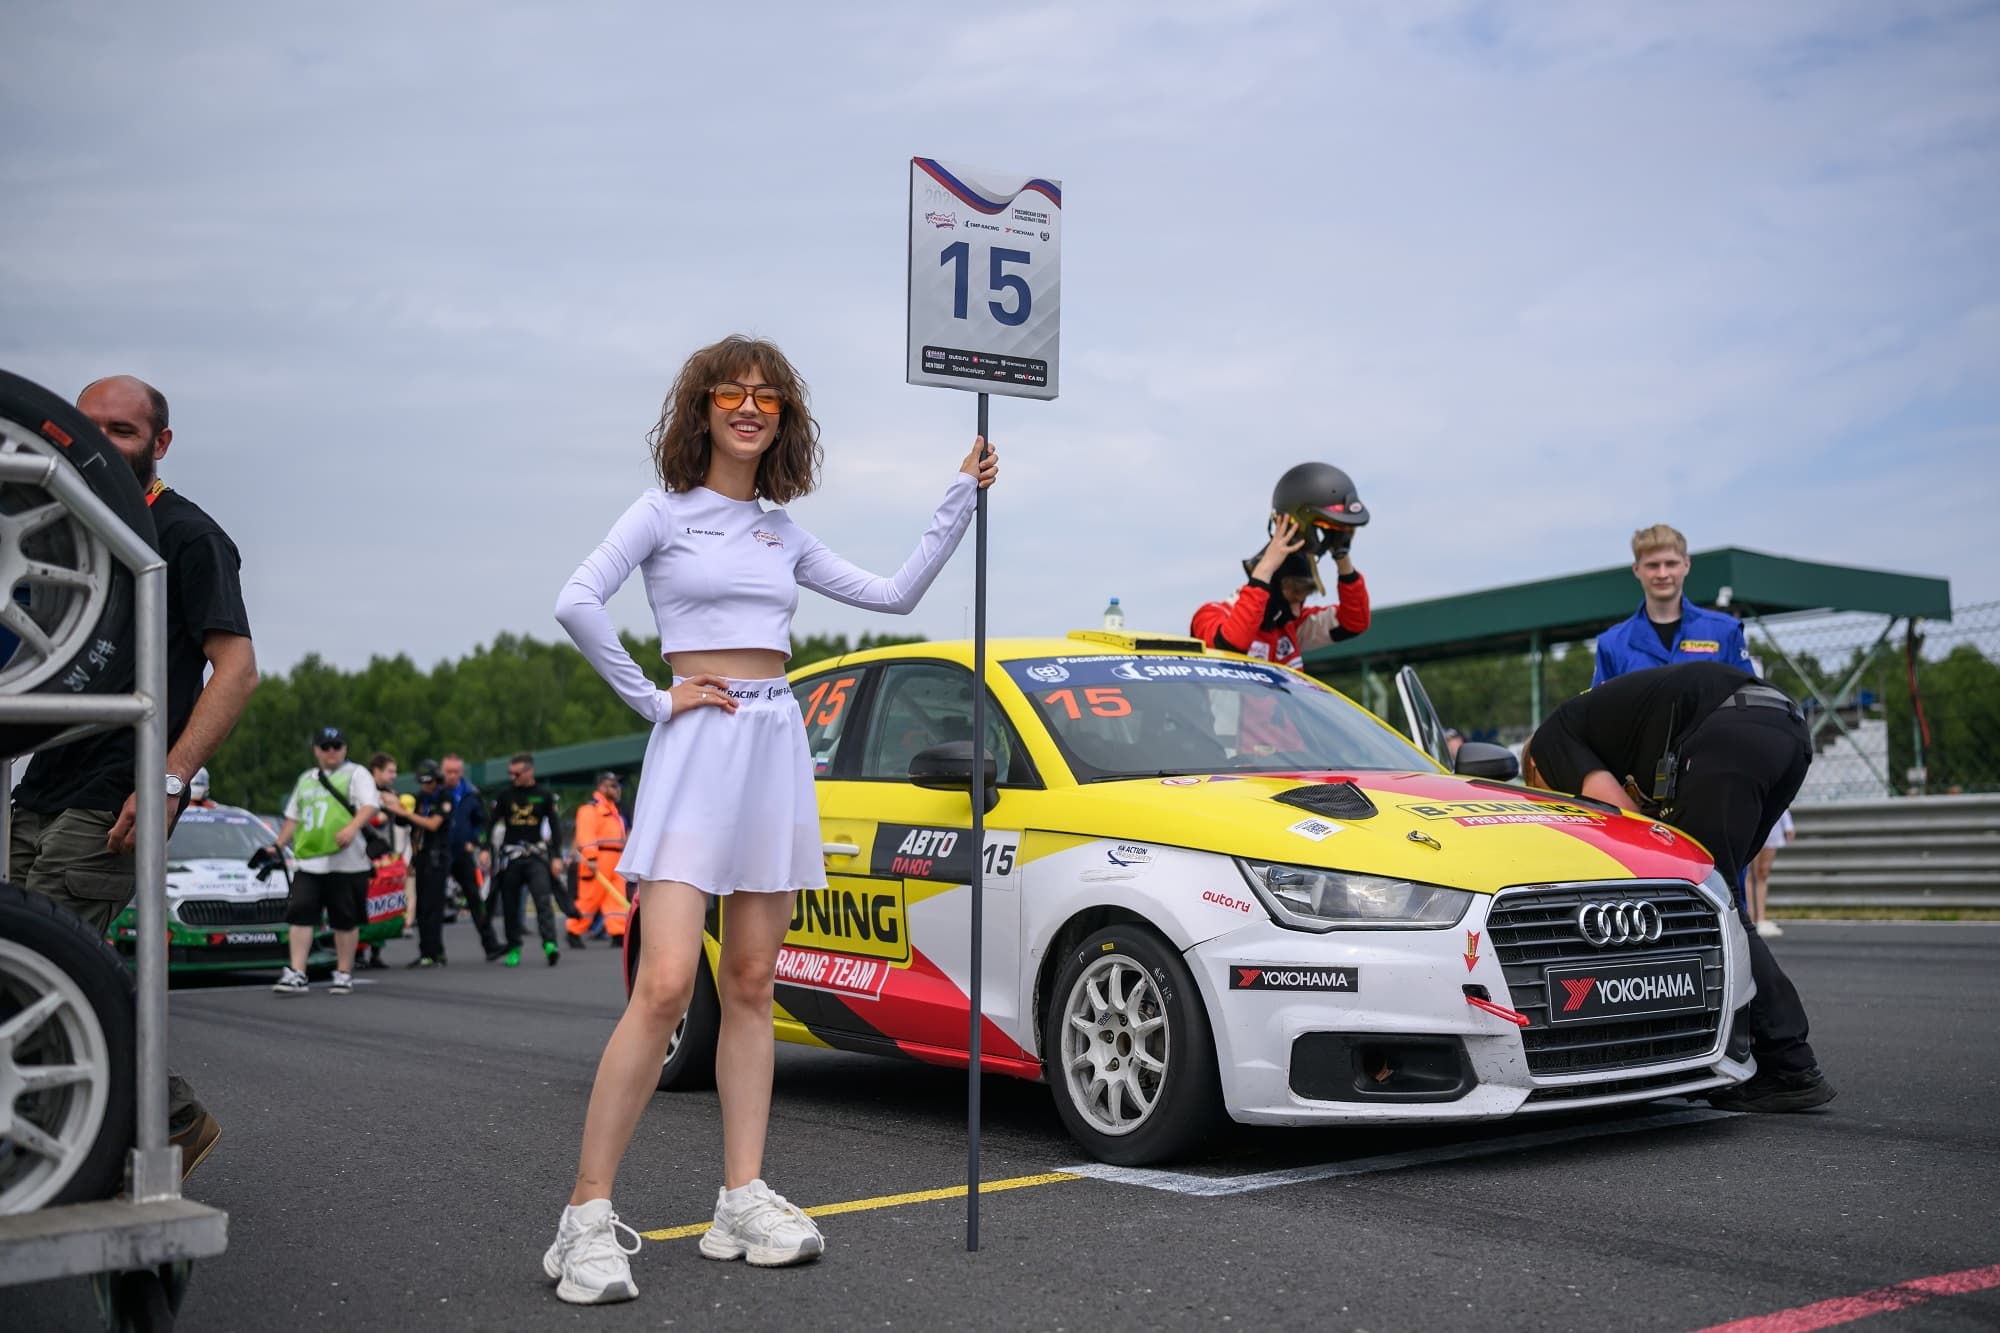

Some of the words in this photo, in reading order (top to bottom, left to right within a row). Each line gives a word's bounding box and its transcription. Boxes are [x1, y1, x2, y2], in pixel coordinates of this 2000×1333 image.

[940, 241, 1031, 326] 15
[1143, 664, 1192, 677] SMP
[1195, 666, 1274, 683] RACING
[727, 690, 760, 699] RACING
[804, 678, 856, 728] 15
[1044, 688, 1132, 720] 15
[303, 801, 328, 832] 97
[1463, 816, 1496, 825] PRO
[1498, 814, 1551, 823] RACING
[1551, 815, 1593, 824] TEAM
[897, 829, 958, 858] АВТО
[1125, 846, 1148, 855] ACTION
[891, 857, 933, 876] ПЛЮС
[983, 843, 1016, 876] 15
[1203, 890, 1251, 912] auto.ru
[788, 889, 899, 943] UNING
[226, 933, 277, 944] YOKOHAMA
[775, 949, 829, 983] RACING
[828, 957, 878, 990] TEAM
[1262, 971, 1348, 987] YOKOHAMA
[1595, 973, 1695, 1004] YOKOHAMA
